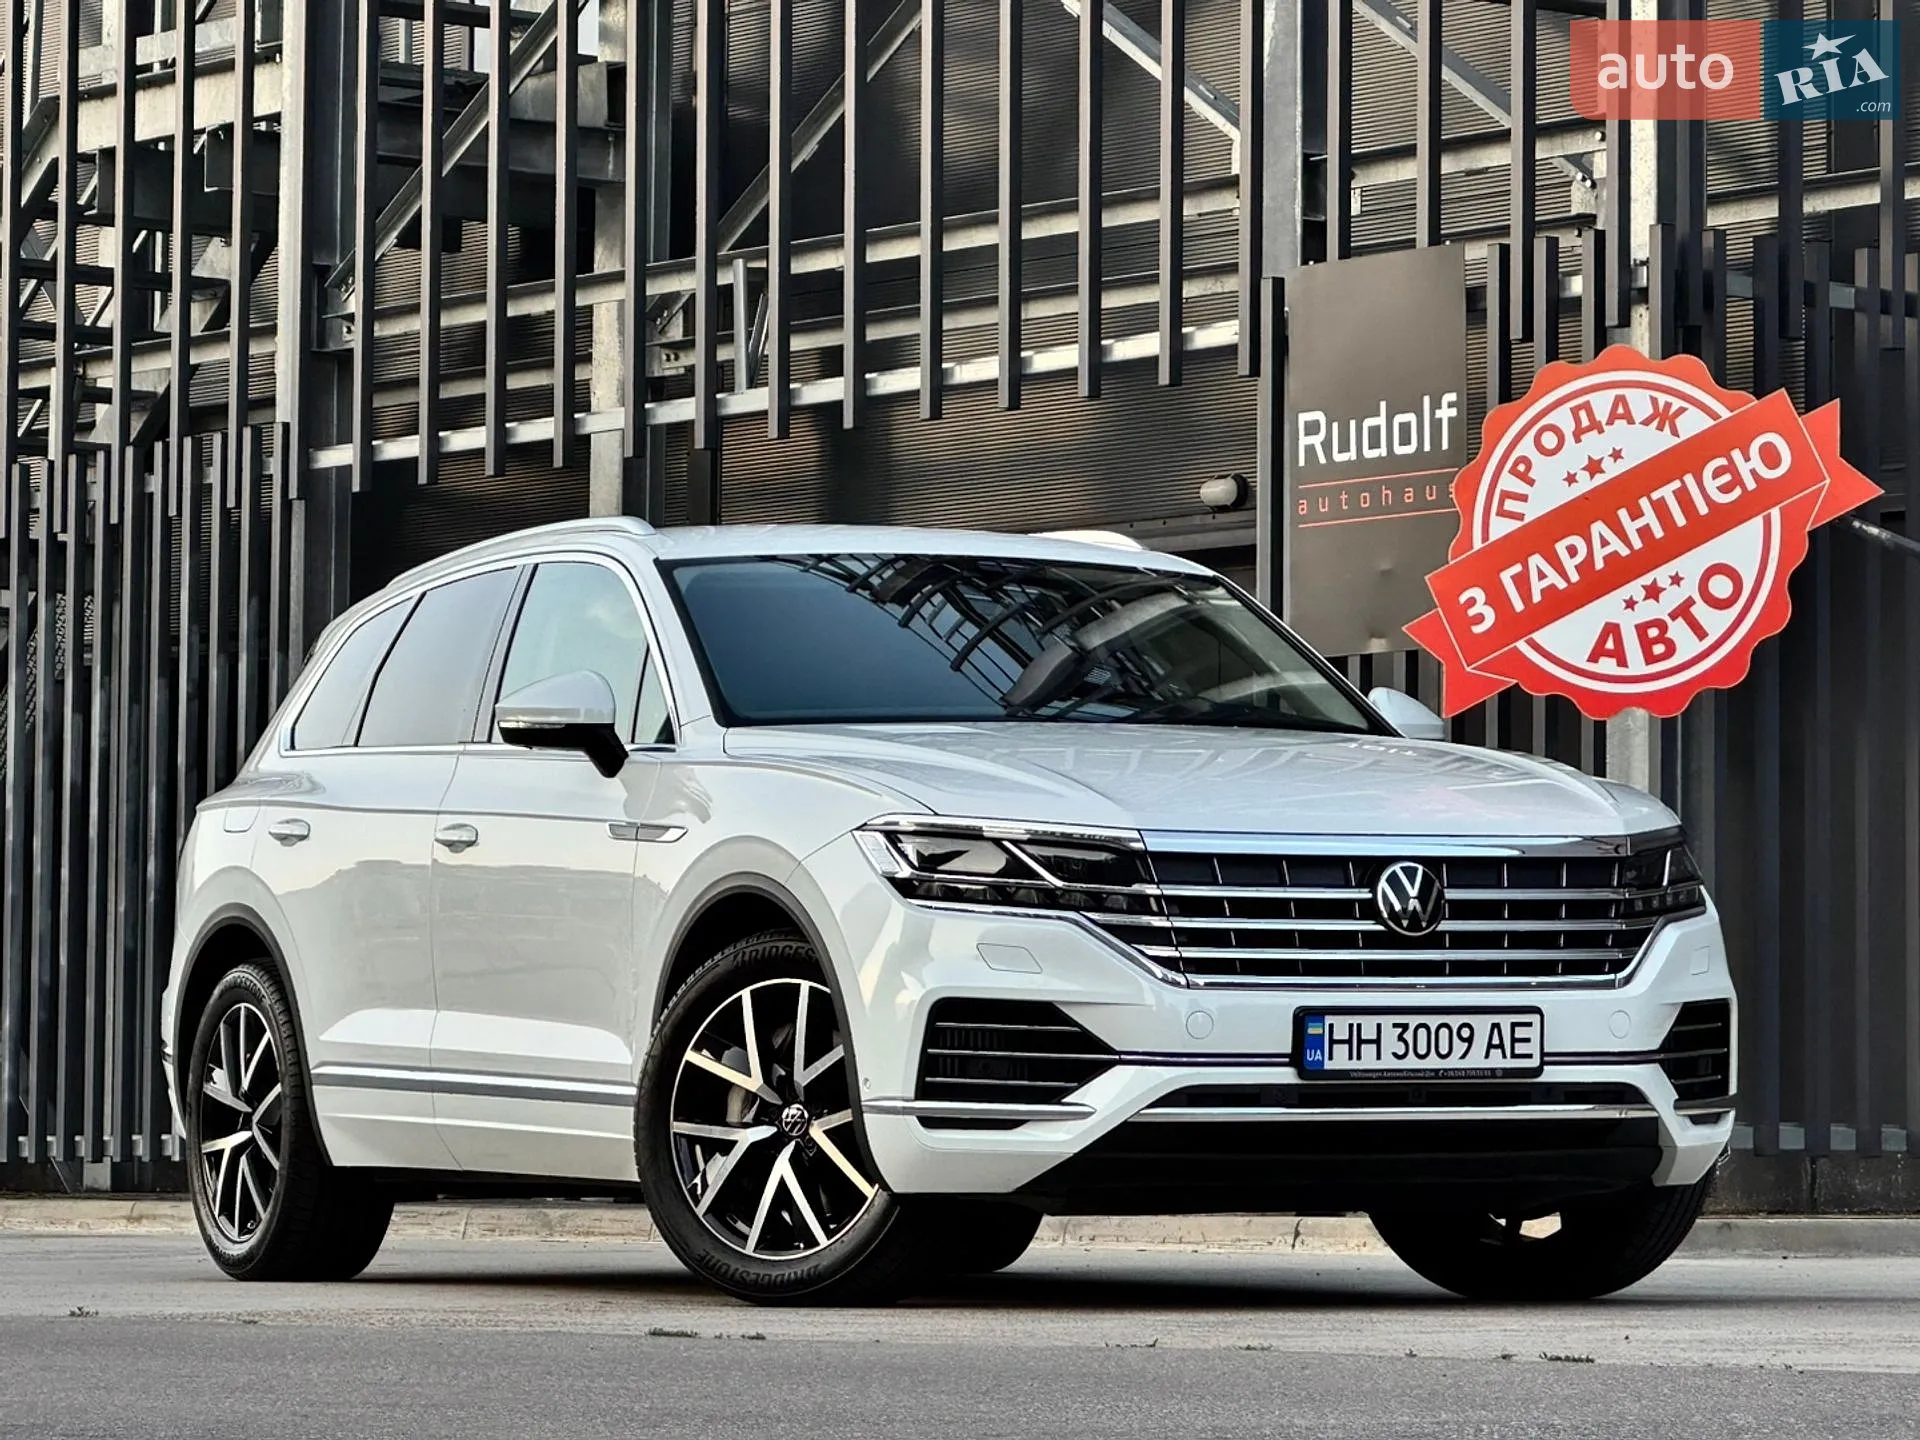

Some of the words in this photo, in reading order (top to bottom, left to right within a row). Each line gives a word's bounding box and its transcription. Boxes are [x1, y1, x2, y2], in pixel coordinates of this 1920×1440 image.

[1297, 392, 1457, 467] Rudolf
[1306, 1049, 1323, 1062] UA
[1328, 1022, 1382, 1061] HH
[1391, 1022, 1475, 1060] 3009
[1484, 1021, 1534, 1060] AE
